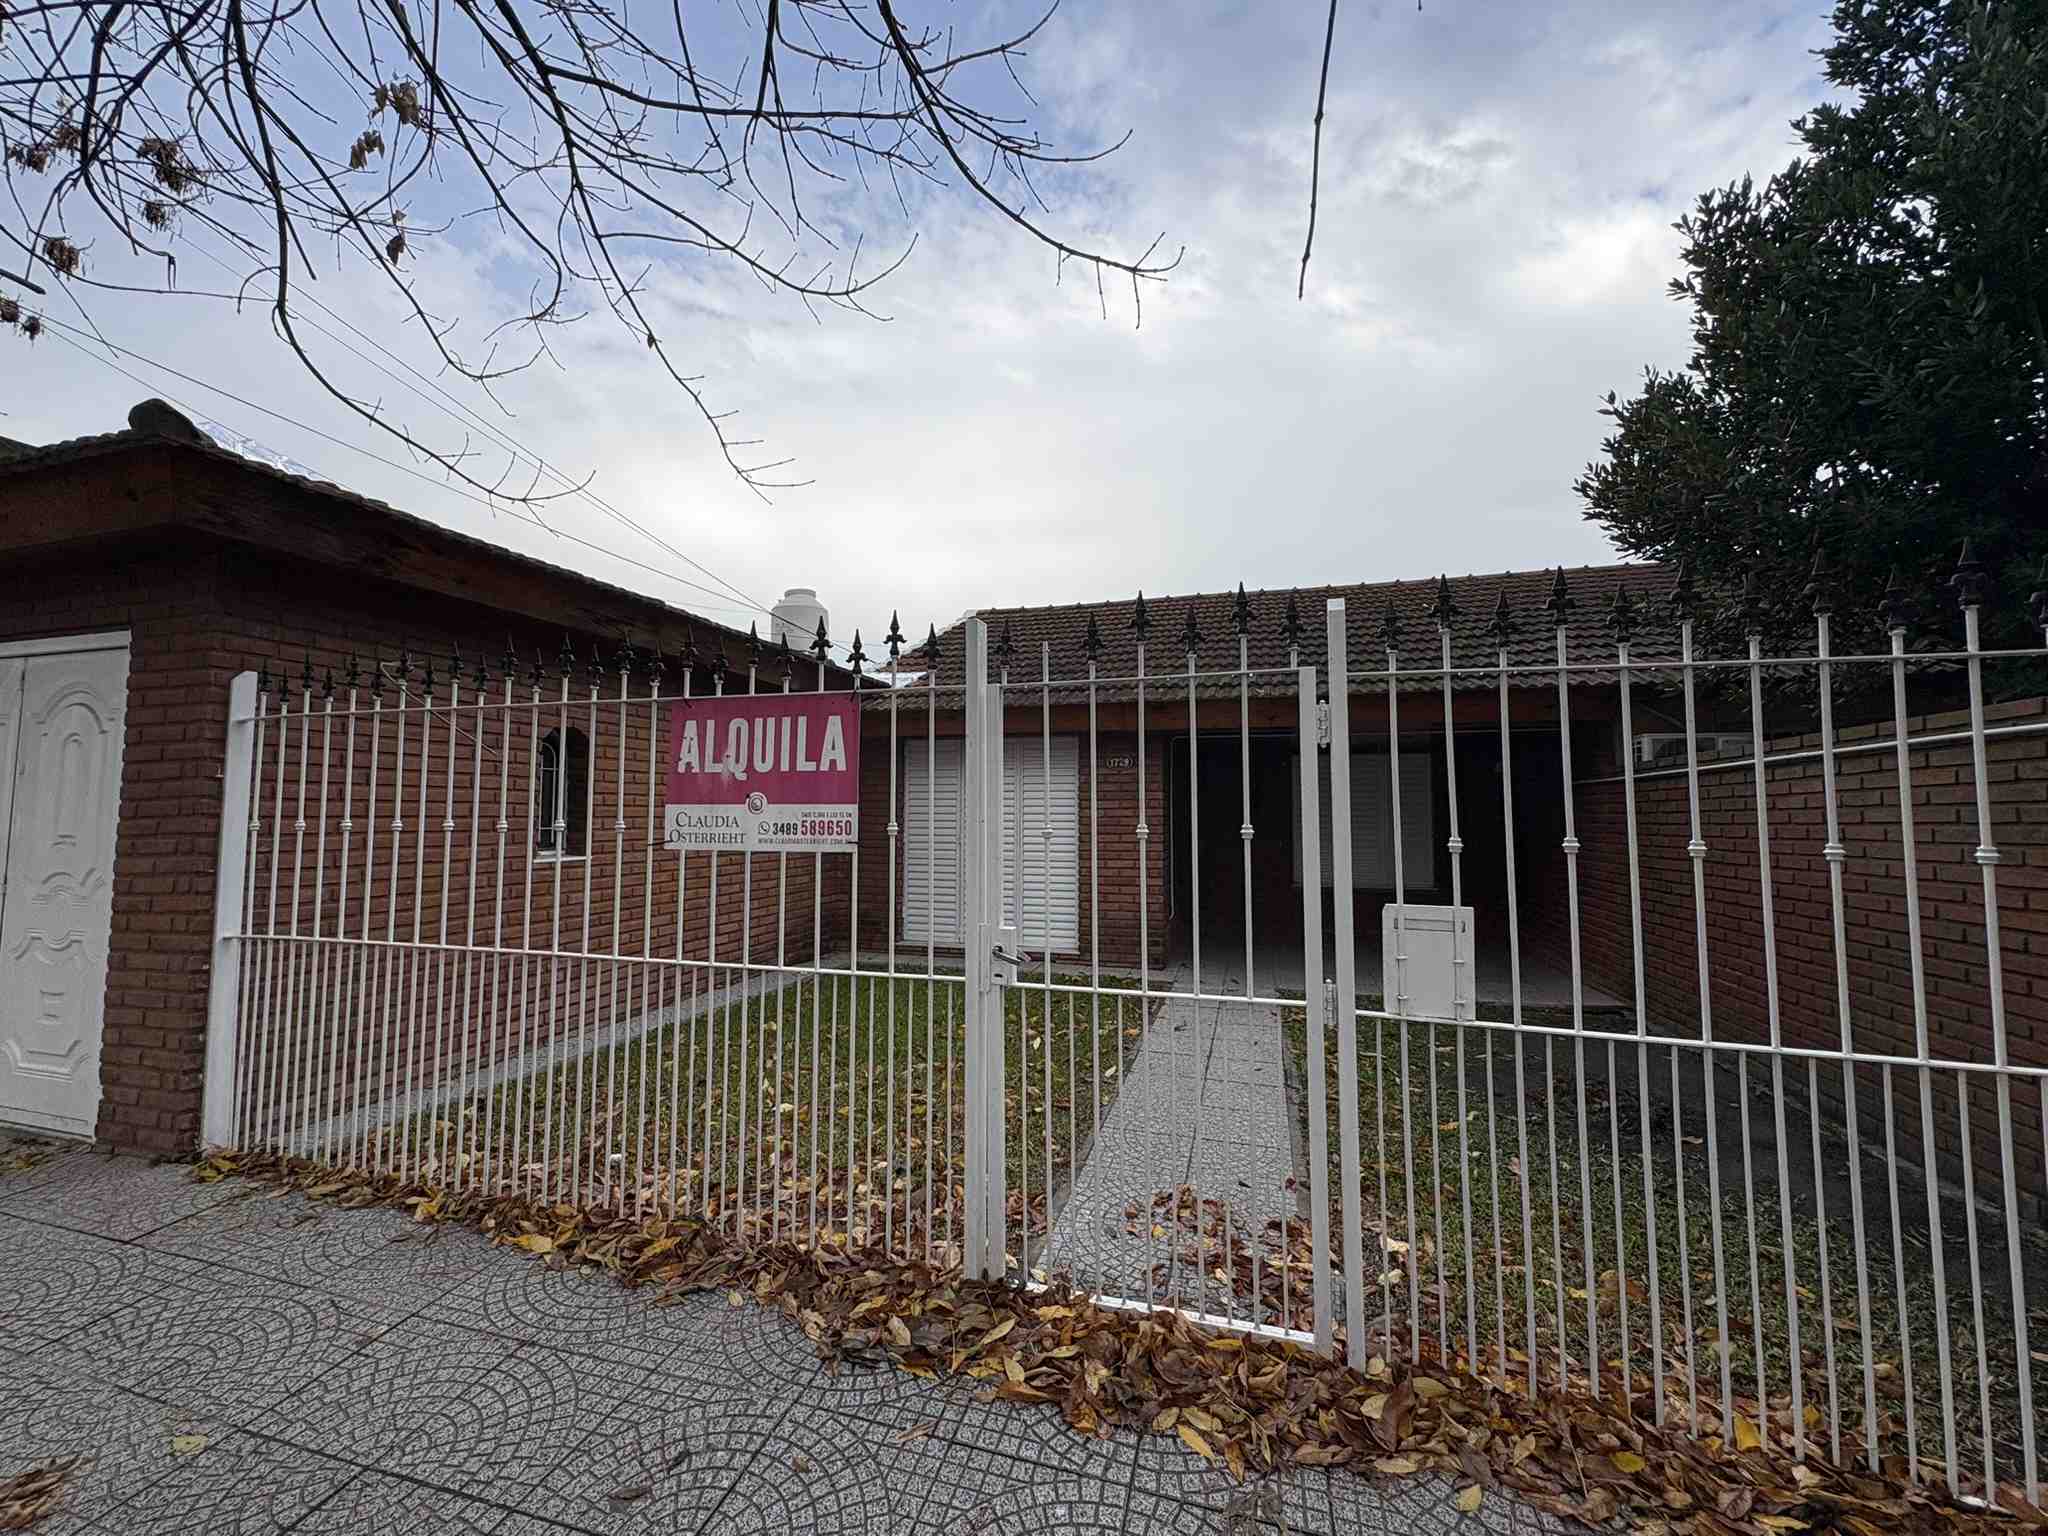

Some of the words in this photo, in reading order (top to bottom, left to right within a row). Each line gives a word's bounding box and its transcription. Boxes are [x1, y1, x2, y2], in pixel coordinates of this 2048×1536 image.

[677, 715, 847, 781] ALQUILA
[675, 811, 740, 828] CLAUDIA
[800, 820, 853, 836] 589650
[669, 829, 747, 844] OSTERRIEHT
